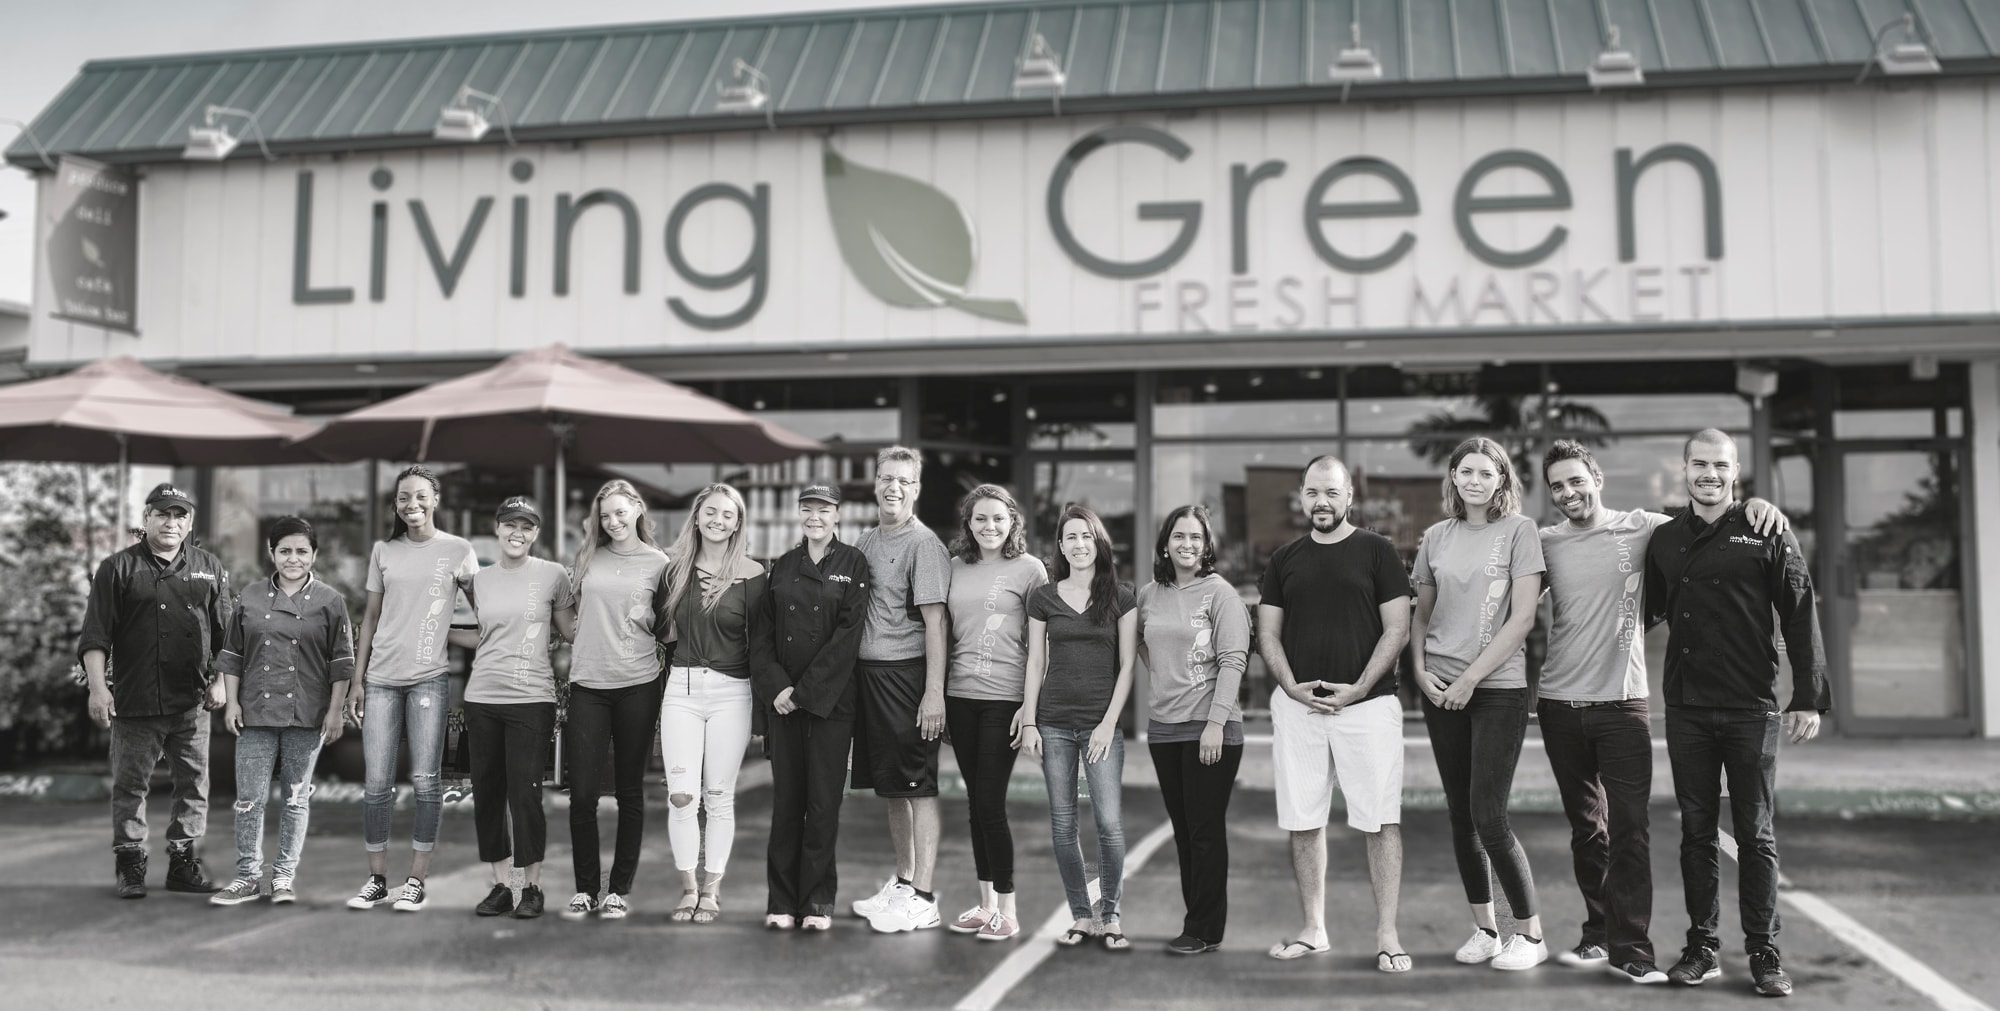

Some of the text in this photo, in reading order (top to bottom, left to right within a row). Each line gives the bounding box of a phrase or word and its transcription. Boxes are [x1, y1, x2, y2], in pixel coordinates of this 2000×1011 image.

[293, 123, 1725, 331] Living Green
[1134, 266, 1713, 334] FRESH MARKET
[1484, 535, 1506, 577] Living
[1613, 528, 1632, 573] Living
[422, 558, 450, 665] Living Green
[519, 582, 541, 687] Living Green
[982, 575, 1008, 677] Living Green
[1193, 650, 1207, 690] Geen
